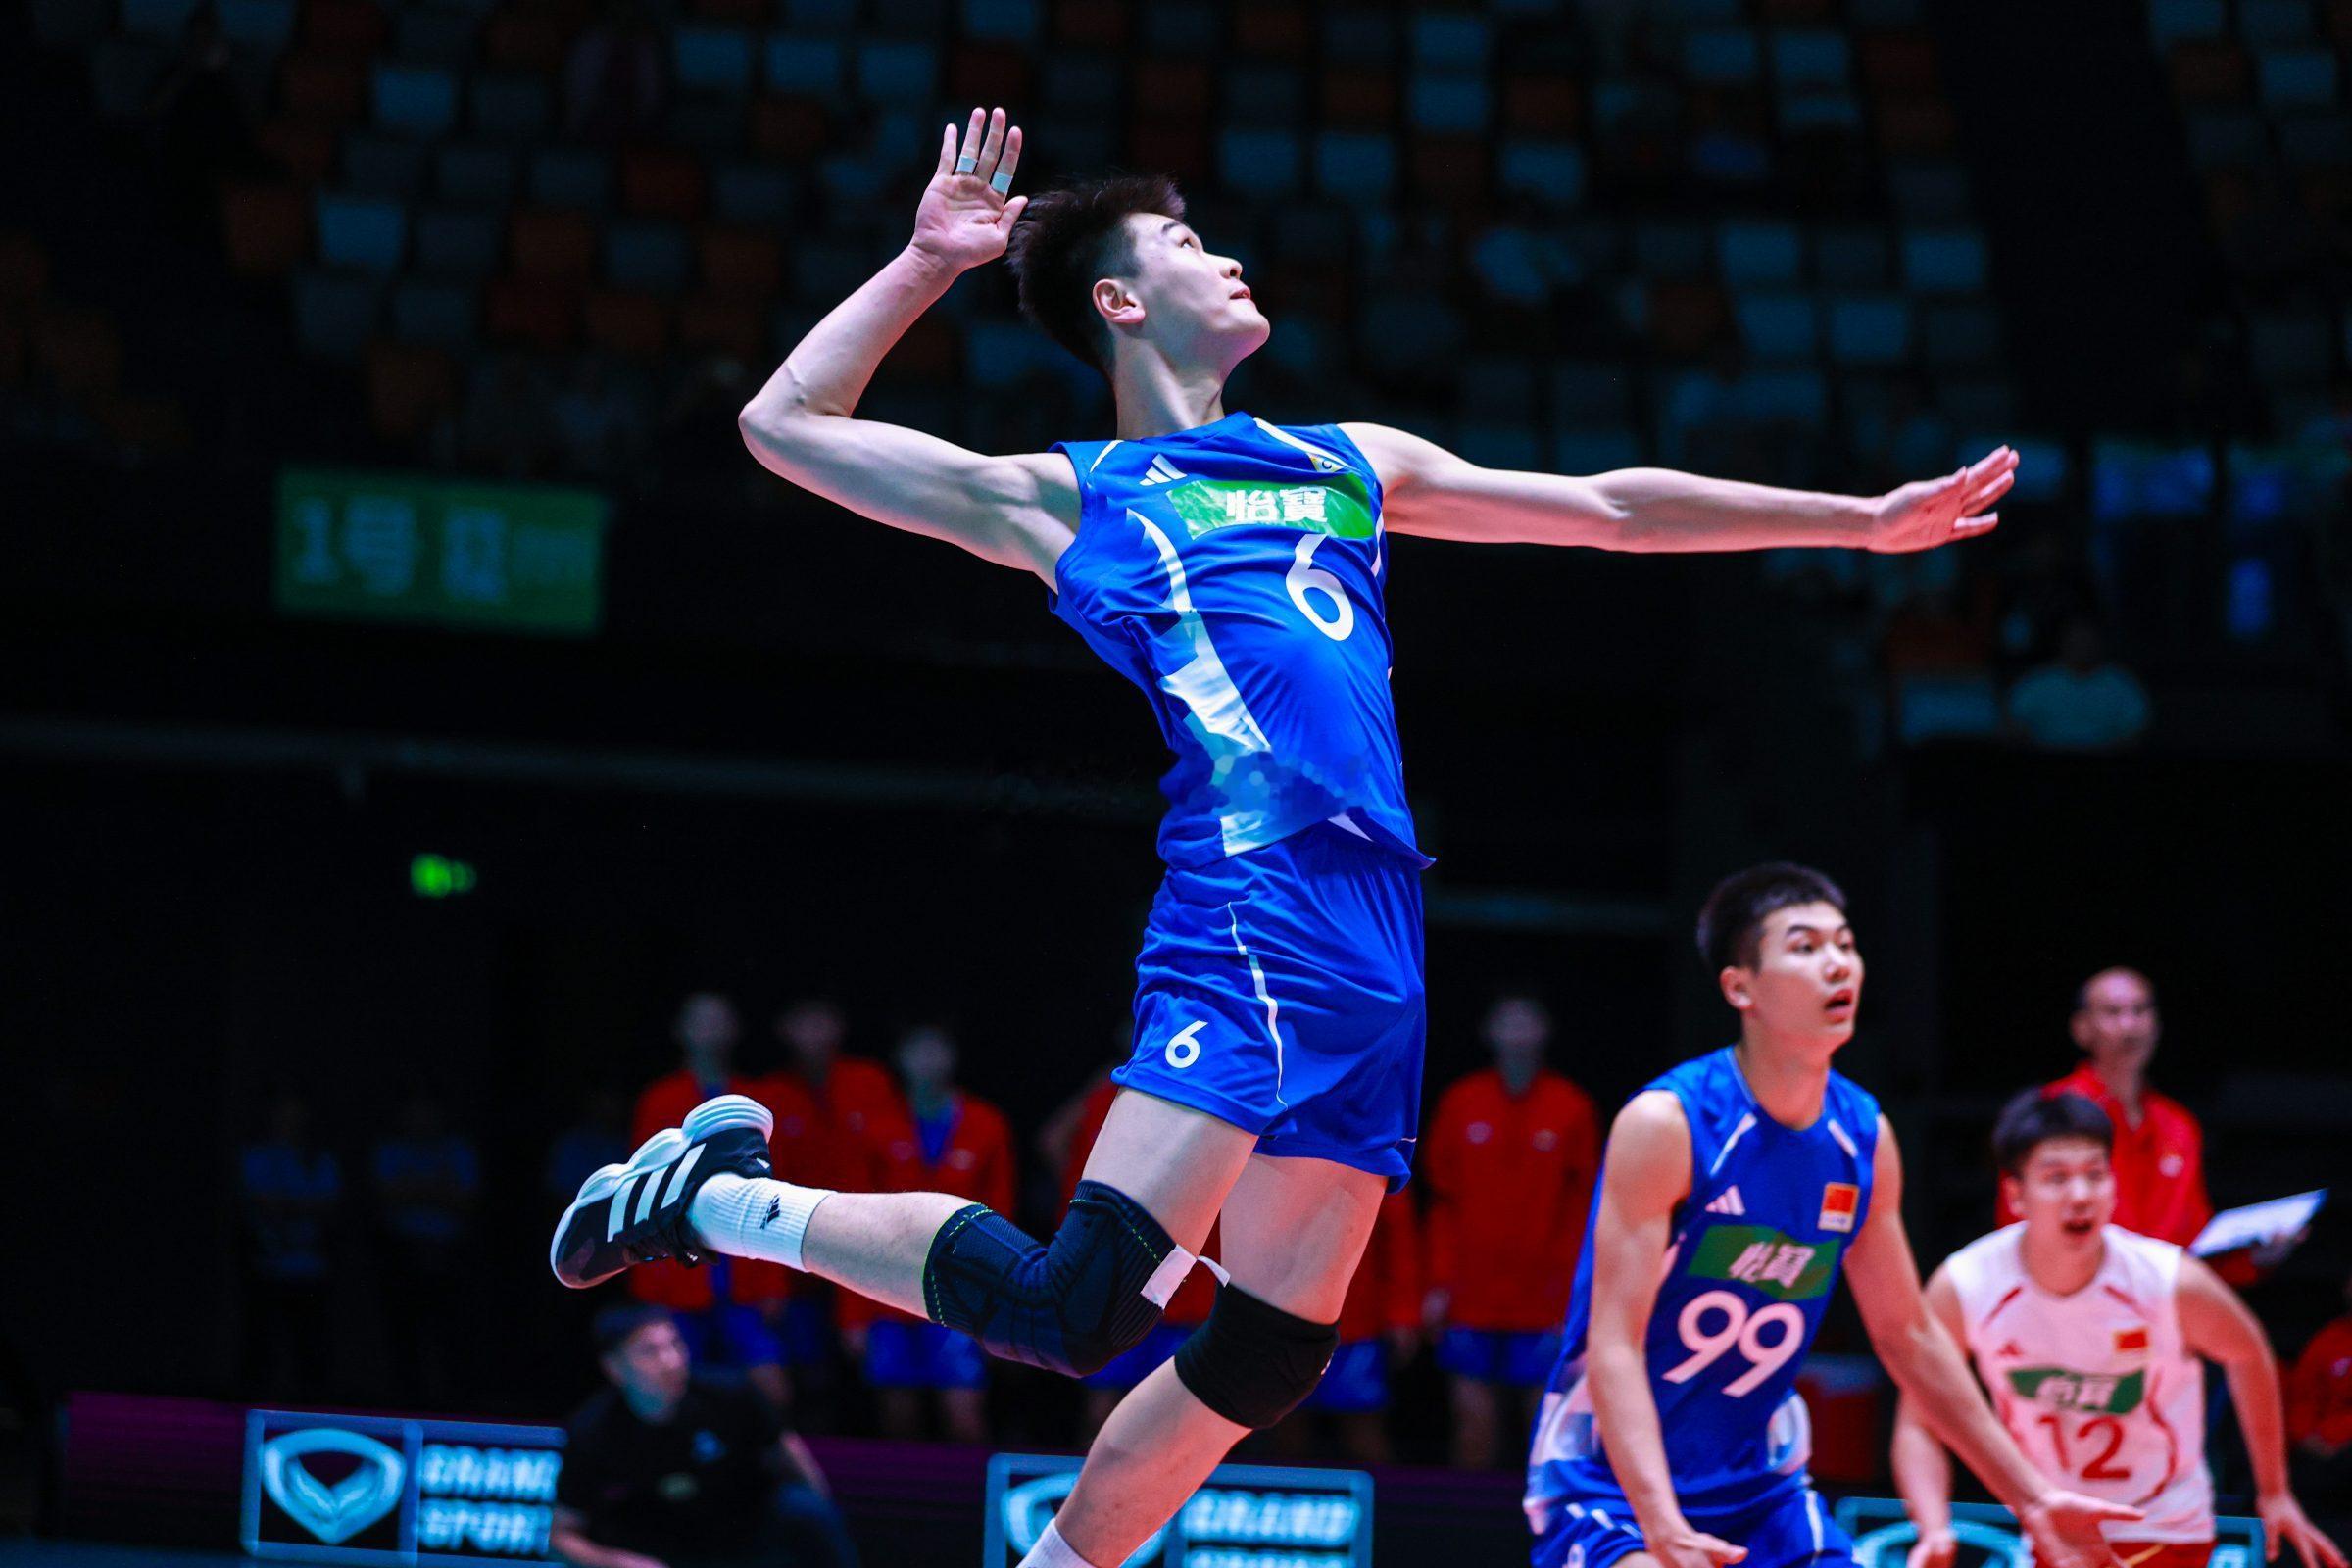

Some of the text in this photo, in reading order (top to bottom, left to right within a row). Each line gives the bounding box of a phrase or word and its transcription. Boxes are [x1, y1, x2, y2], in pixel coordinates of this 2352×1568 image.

[1286, 533, 1354, 641] 6
[1165, 1020, 1208, 1068] 6
[1662, 1290, 1805, 1398] 99
[2036, 1415, 2132, 1482] 12
